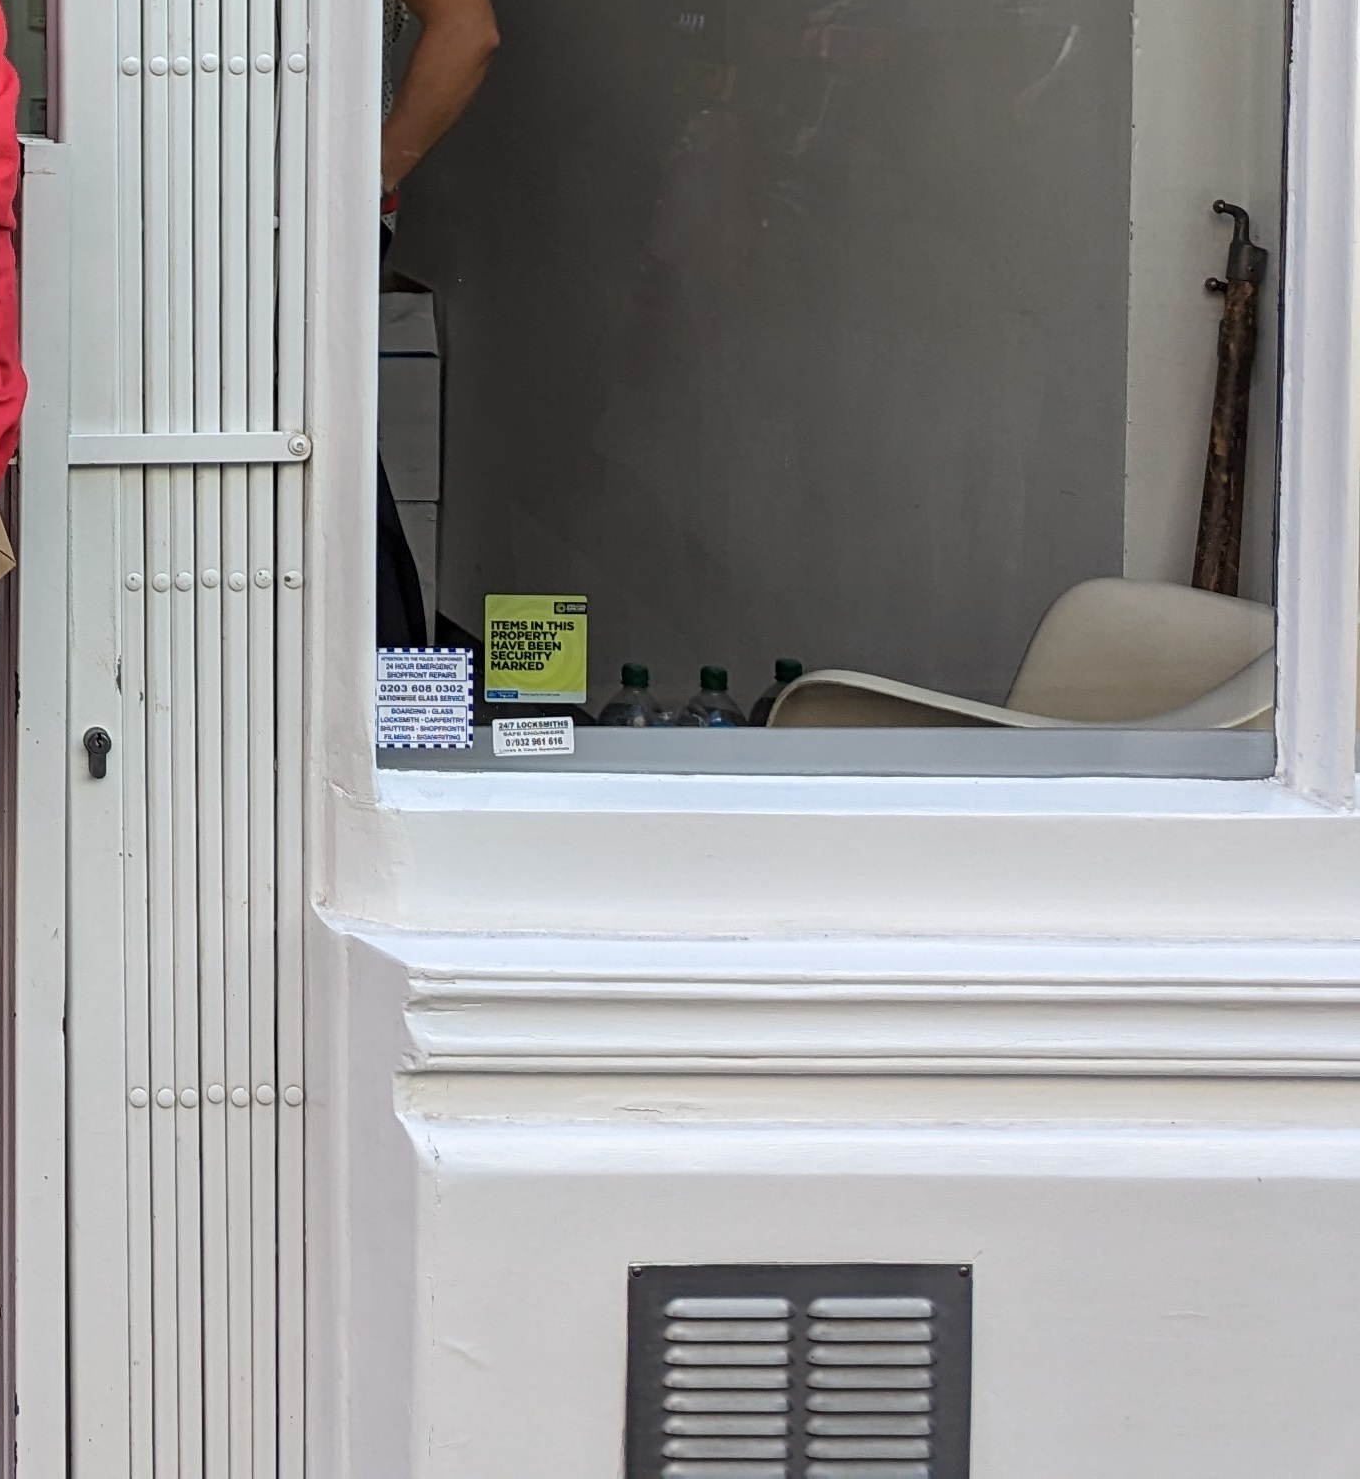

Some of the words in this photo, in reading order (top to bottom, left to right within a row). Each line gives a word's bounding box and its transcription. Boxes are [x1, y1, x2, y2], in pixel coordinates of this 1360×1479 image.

[491, 620, 528, 631] ITEMS
[530, 620, 544, 631] IN
[546, 621, 575, 631] THIS
[491, 631, 558, 641] PROPERTY
[491, 641, 525, 651] HAVE
[528, 641, 562, 651] BEEN
[491, 651, 552, 661] SECURITY
[491, 660, 545, 671] MARKED
[387, 671, 428, 679] SHOPFRONT
[429, 671, 457, 679] REPAIRS
[380, 684, 408, 692] 0203
[436, 684, 464, 692] 0302
[517, 720, 569, 728] LOCKSMITHS
